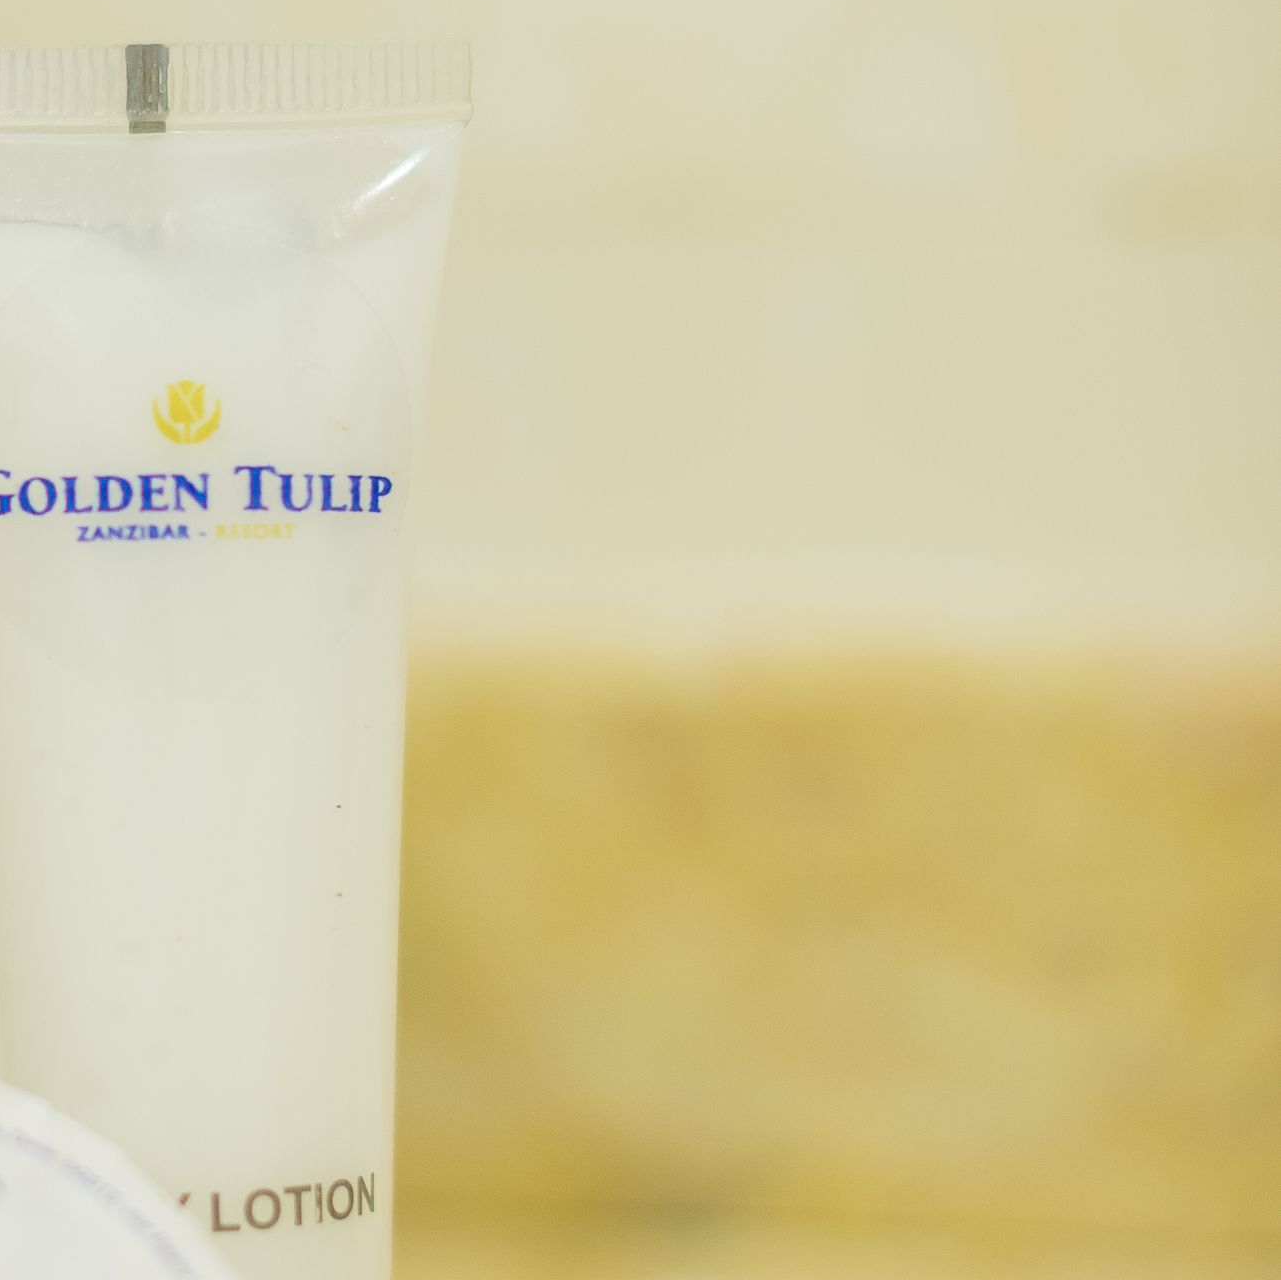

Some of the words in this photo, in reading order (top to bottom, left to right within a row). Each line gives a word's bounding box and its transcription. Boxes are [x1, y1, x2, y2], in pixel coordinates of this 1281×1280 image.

[234, 465, 393, 513] TULIP
[76, 524, 190, 542] ZANZIBAR
[215, 523, 296, 540] RESORT
[210, 1172, 376, 1232] LOTION
